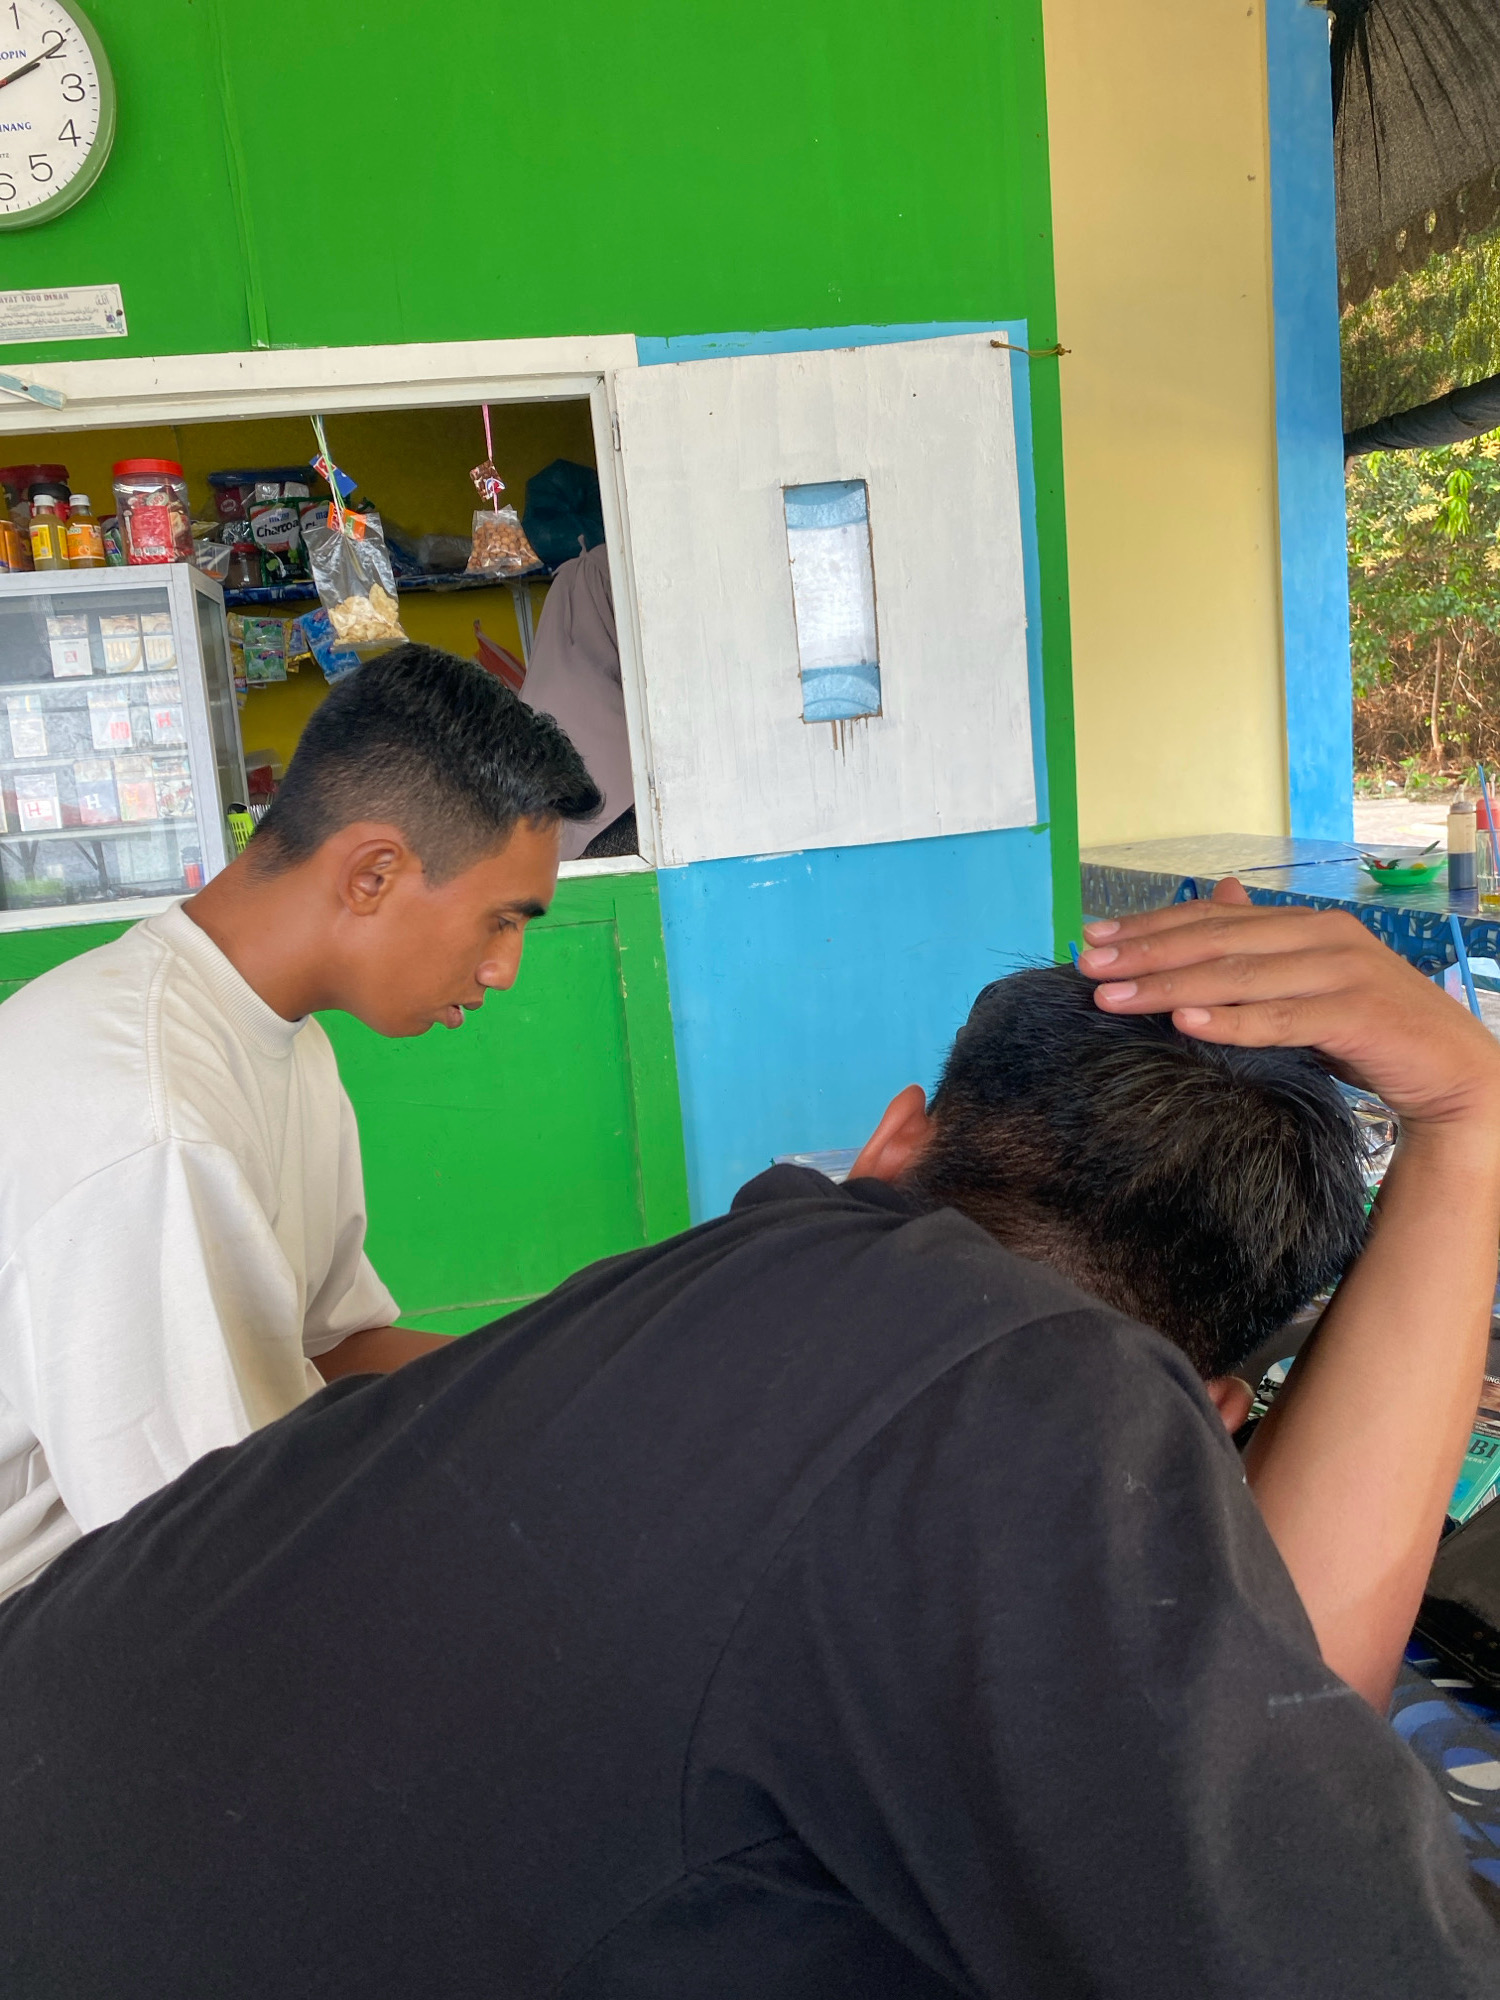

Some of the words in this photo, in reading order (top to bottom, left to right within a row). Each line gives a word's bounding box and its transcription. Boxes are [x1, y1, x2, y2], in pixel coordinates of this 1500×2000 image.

[9, 2, 20, 30] 1
[0, 49, 27, 60] OPIN
[42, 29, 67, 59] 2
[60, 73, 86, 102] 3
[58, 118, 82, 147] 4
[28, 153, 54, 182] 5
[21, 294, 42, 302] 1000
[44, 292, 70, 301] DINAR
[84, 793, 102, 810] H
